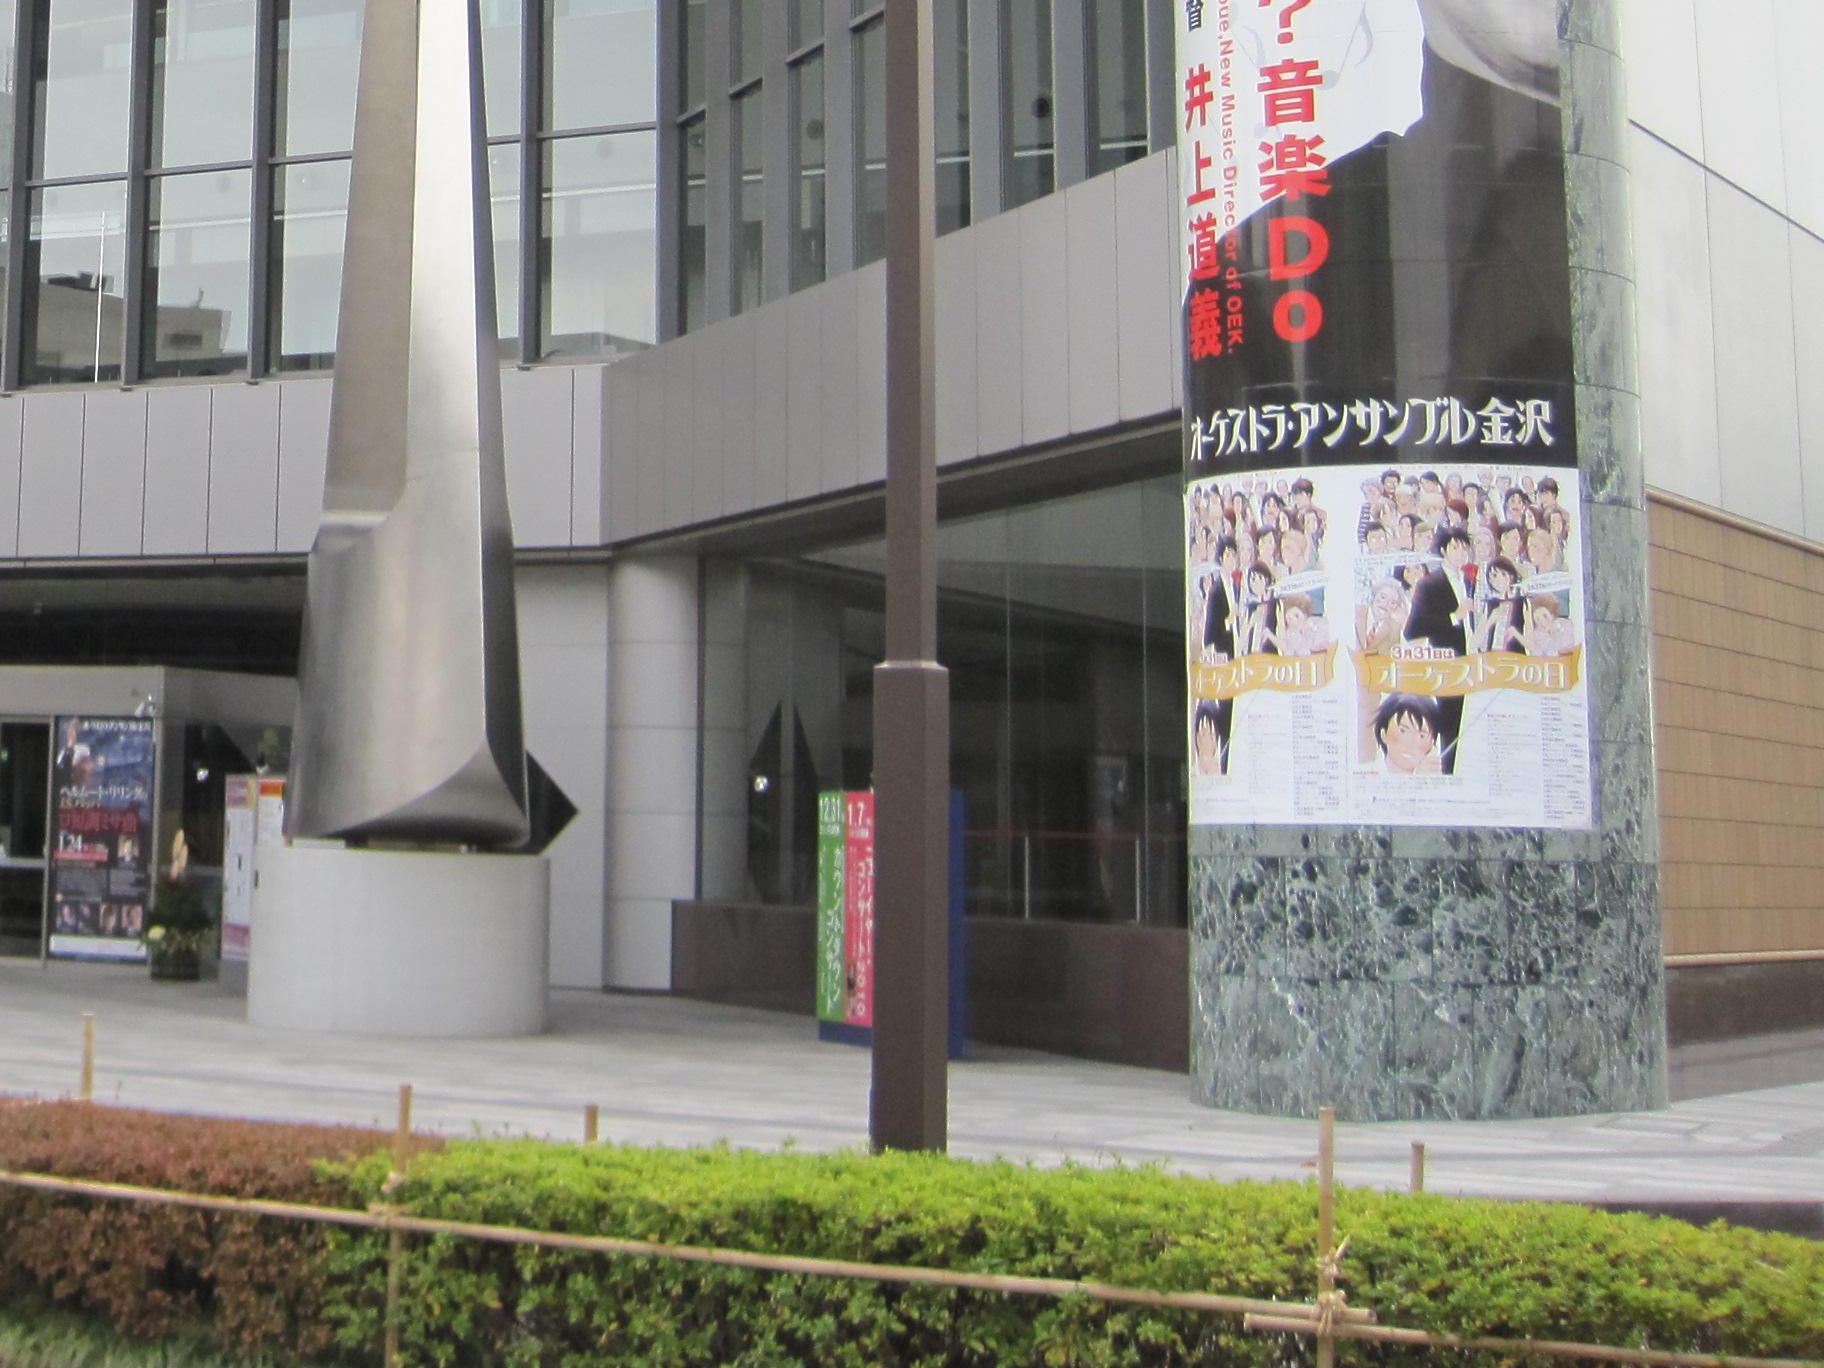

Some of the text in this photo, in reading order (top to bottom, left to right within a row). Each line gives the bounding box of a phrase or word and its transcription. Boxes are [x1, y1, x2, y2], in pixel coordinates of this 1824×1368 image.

[1221, 94, 1236, 161] Music
[1225, 266, 1242, 290] of
[1377, 657, 1568, 690] オーケストラの日
